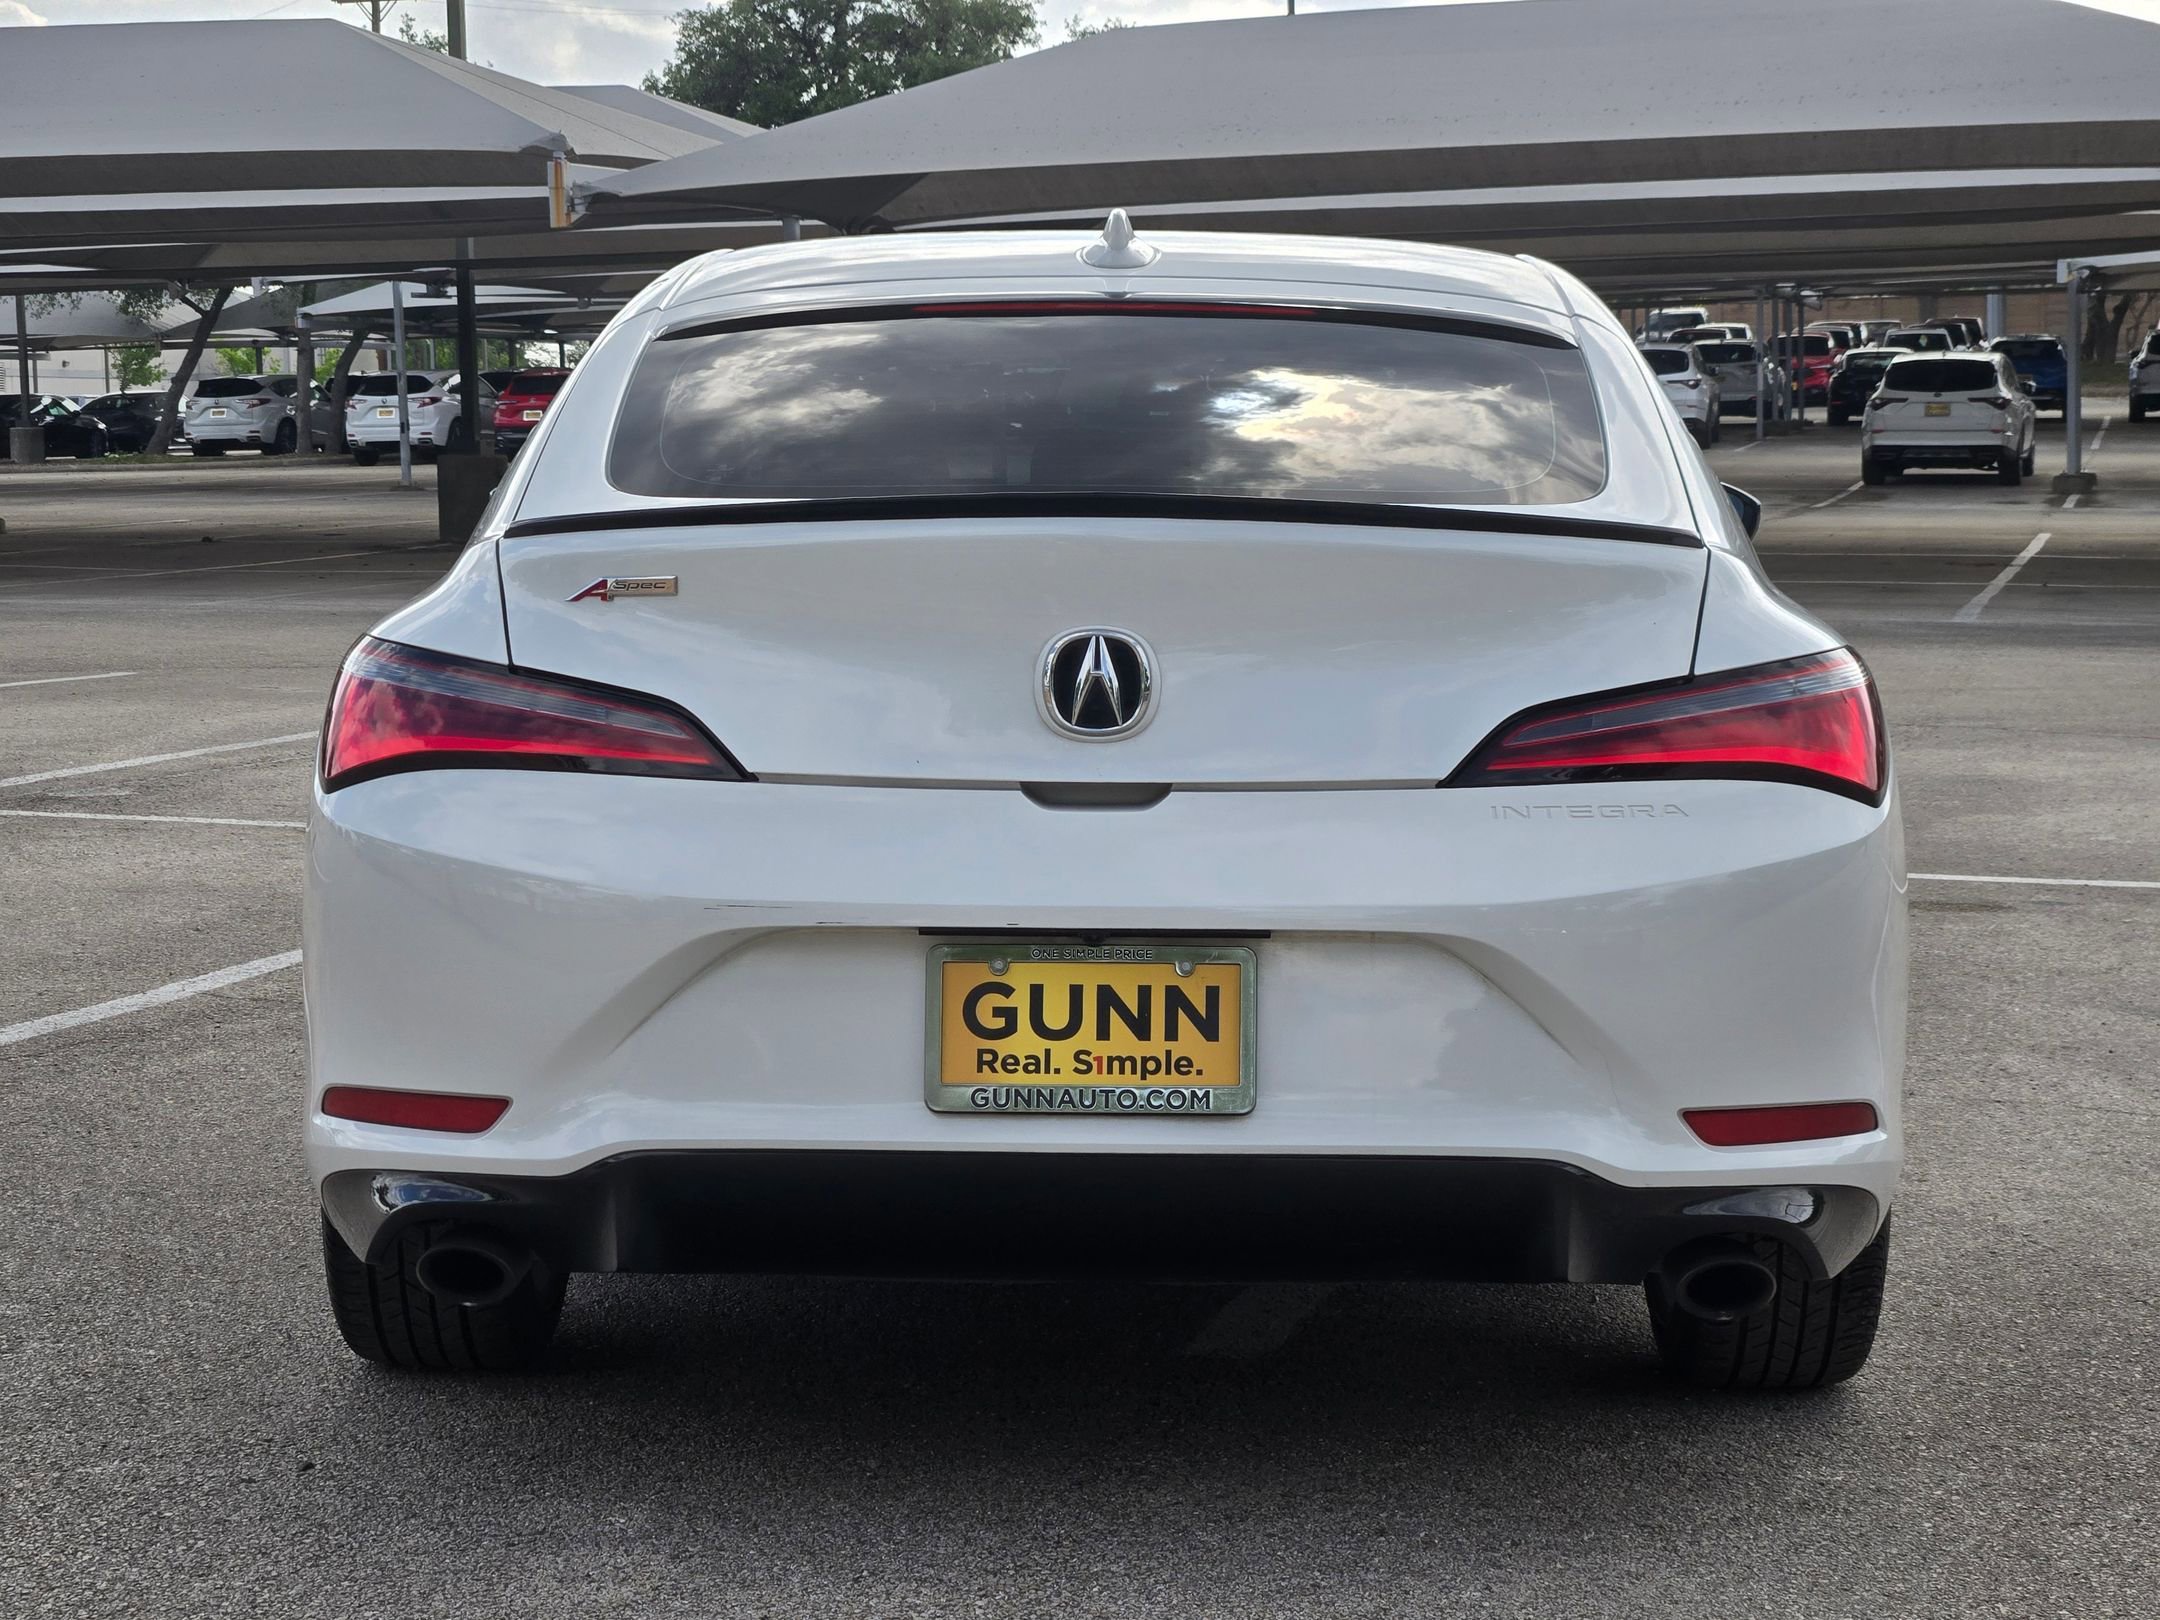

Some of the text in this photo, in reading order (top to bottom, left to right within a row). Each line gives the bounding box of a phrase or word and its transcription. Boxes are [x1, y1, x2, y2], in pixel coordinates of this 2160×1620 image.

[1490, 804, 1689, 819] INTEGRA
[1031, 948, 1153, 960] ONE SIMPLE PRICE
[962, 981, 1220, 1042] GUNN
[976, 1048, 1060, 1075] Real.
[971, 1087, 1212, 1110] GUNNAUTO.COM
